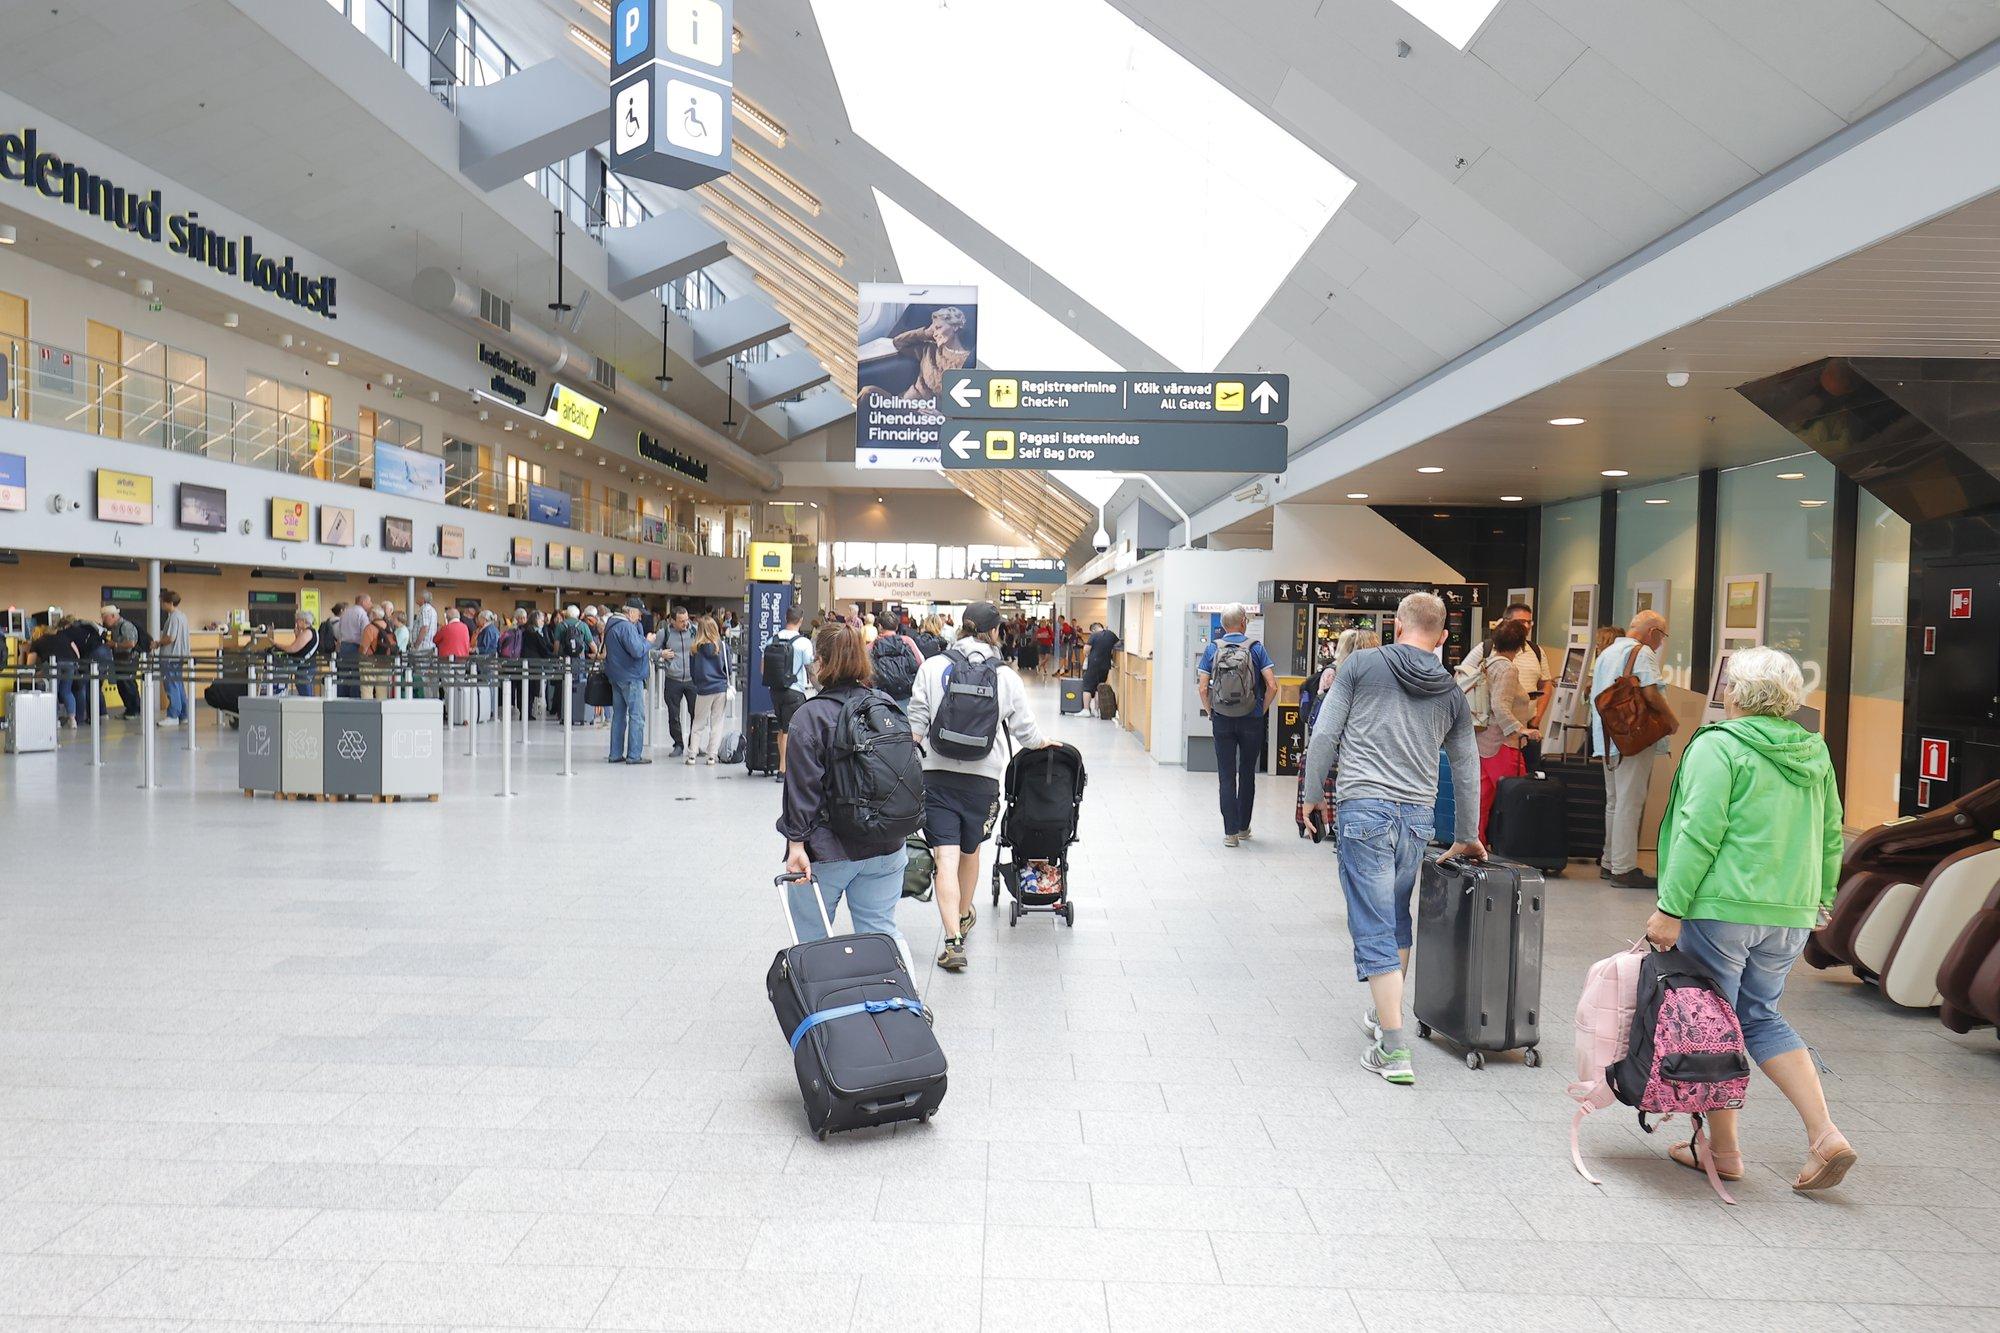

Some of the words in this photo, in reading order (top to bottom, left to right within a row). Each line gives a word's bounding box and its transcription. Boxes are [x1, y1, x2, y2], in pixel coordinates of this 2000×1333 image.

[168, 211, 237, 275] sinu
[243, 235, 337, 319] kodust!
[1021, 380, 1117, 394] Registreerimine
[1133, 382, 1160, 394] Kõik
[1163, 382, 1212, 395] väravad
[869, 393, 937, 409] Üleilmsed
[1021, 396, 1069, 407] Check-in
[1160, 399, 1176, 410] All
[1179, 399, 1212, 410] Gates
[562, 402, 590, 430] airBaltic
[868, 427, 938, 443] Finnairiga
[1019, 431, 1060, 446] Pagasi
[1063, 431, 1140, 445] iseteenindus
[1019, 447, 1041, 459] Self
[1043, 447, 1065, 461] Bag
[1067, 447, 1095, 461] Drop
[283, 514, 299, 527] Sale
[113, 530, 122, 548] 4
[193, 538, 200, 554] 5
[281, 546, 286, 560] 6
[329, 550, 334, 564] 7
[391, 557, 397, 569] 8
[872, 580, 914, 588] Väljumised
[891, 589, 931, 597] Departures
[761, 592, 770, 610] Self
[771, 592, 782, 623] Pagasi
[759, 611, 770, 629] Bag
